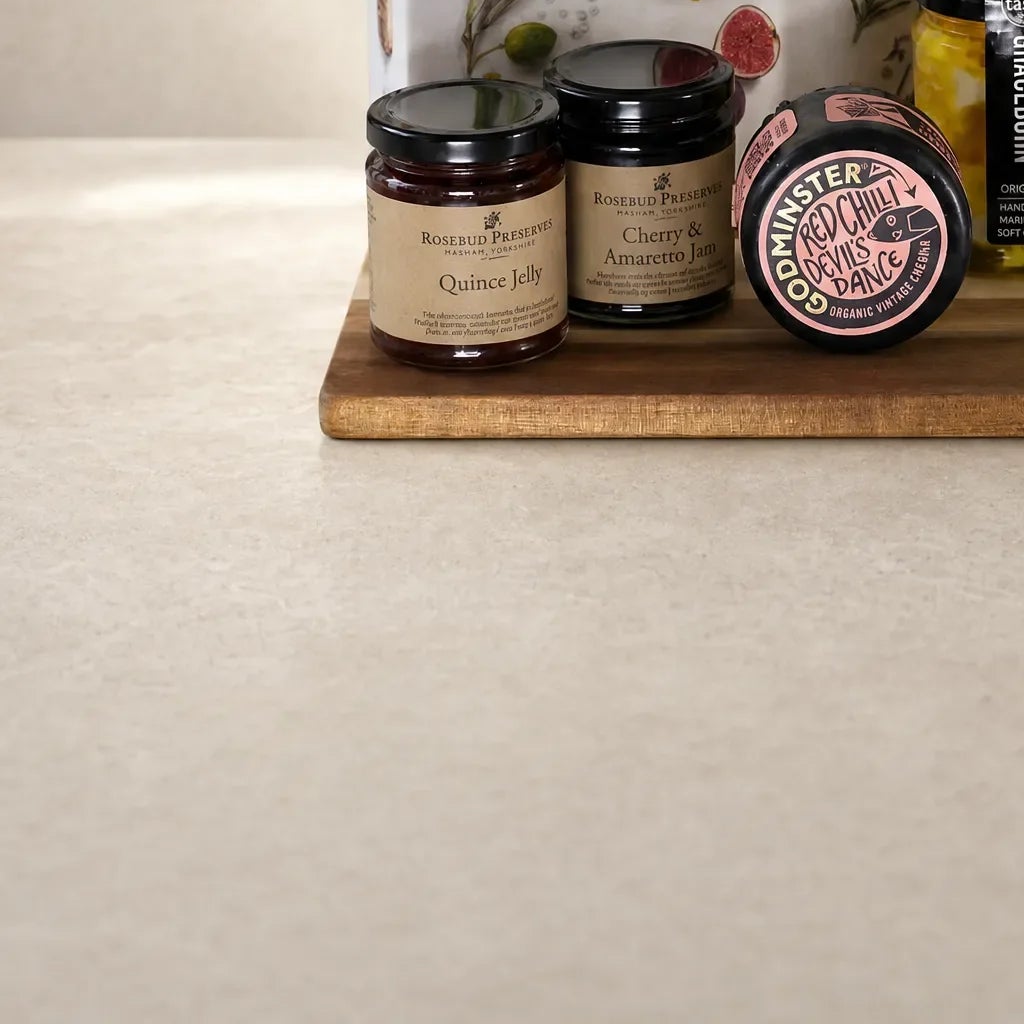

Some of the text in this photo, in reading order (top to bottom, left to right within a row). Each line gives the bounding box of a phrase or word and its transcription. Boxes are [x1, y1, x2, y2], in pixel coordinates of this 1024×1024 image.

[622, 220, 702, 246] Cherry &
[799, 179, 900, 257] RED CHILLI
[997, 228, 1021, 238] SOFT
[603, 241, 717, 266] Amaretto Jam
[770, 162, 863, 316] GODMINSTER
[439, 263, 543, 295] Quince Jelly
[803, 236, 871, 285] DEVIL'S
[831, 250, 902, 296] DANCE
[829, 305, 874, 320] ORGANIC
[876, 281, 914, 313] VINTAGE
